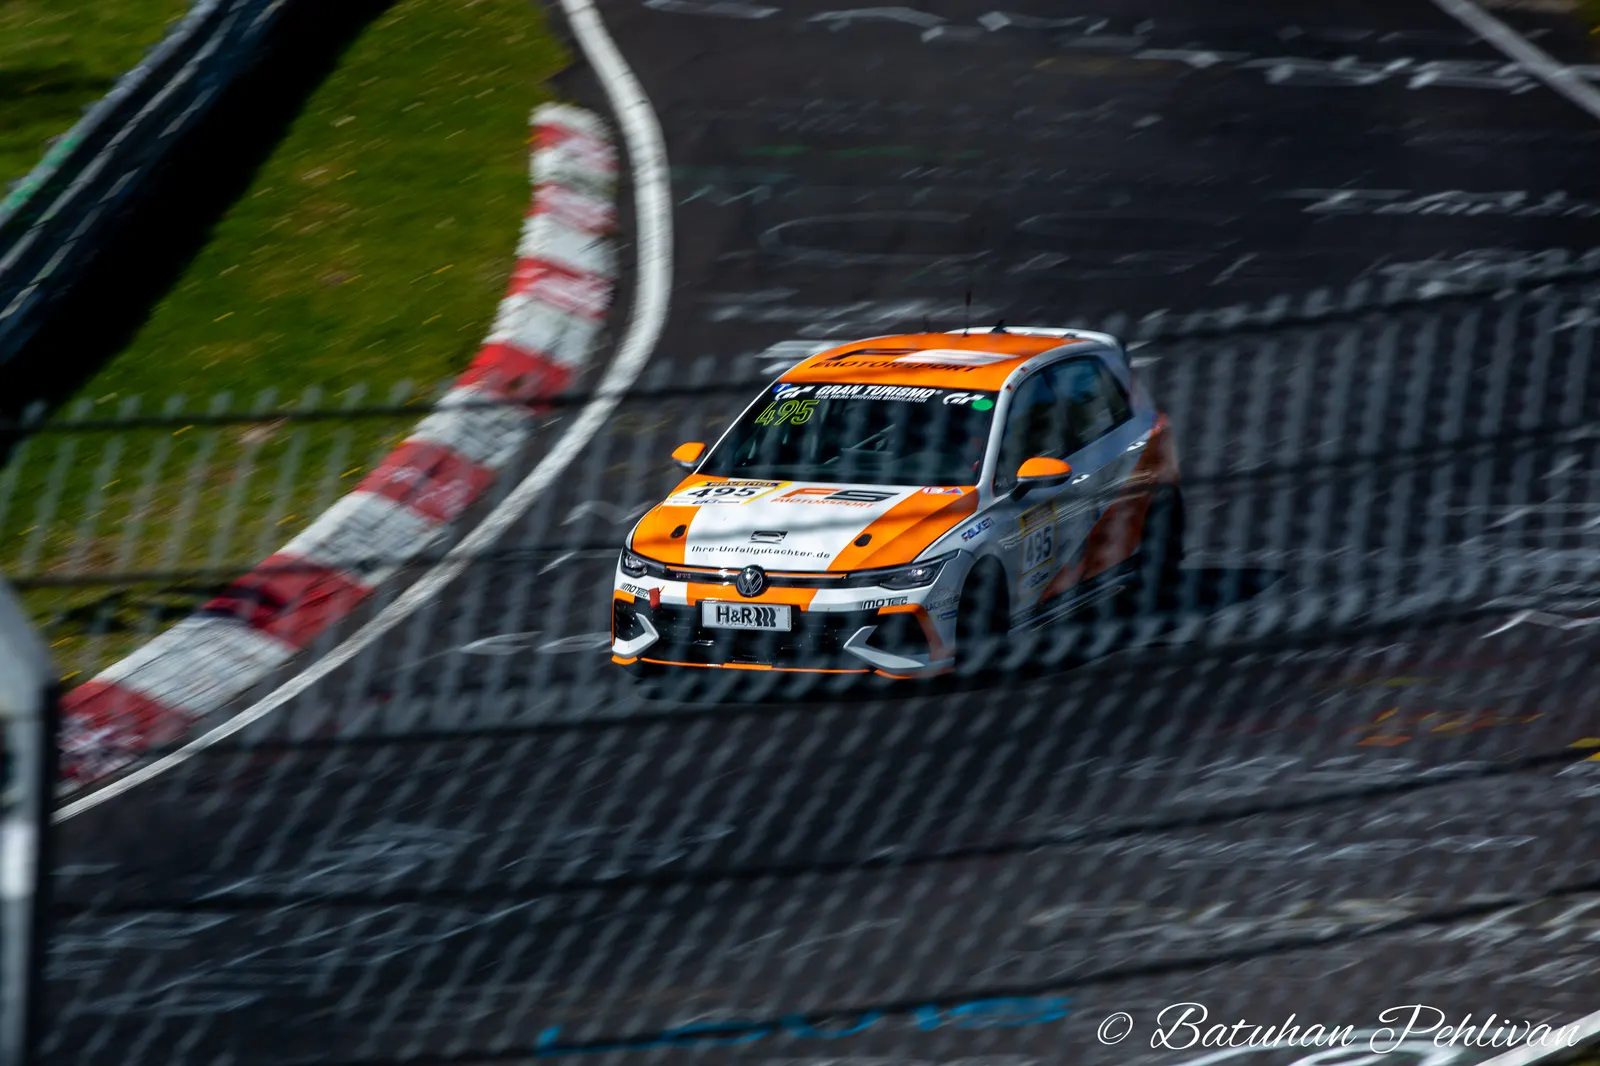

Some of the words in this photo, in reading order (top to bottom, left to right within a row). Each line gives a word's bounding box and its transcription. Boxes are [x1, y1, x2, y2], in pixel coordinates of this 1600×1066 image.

[814, 385, 864, 396] GRAN
[863, 385, 937, 398] TURISMO
[754, 399, 820, 426] 495
[688, 487, 760, 498] 495
[781, 487, 900, 503] FS
[771, 498, 874, 509] MOTORSPORT
[691, 545, 831, 559] Ihre-Unfallgutachter.de
[1024, 525, 1052, 567] 495
[717, 605, 752, 626] H&R
